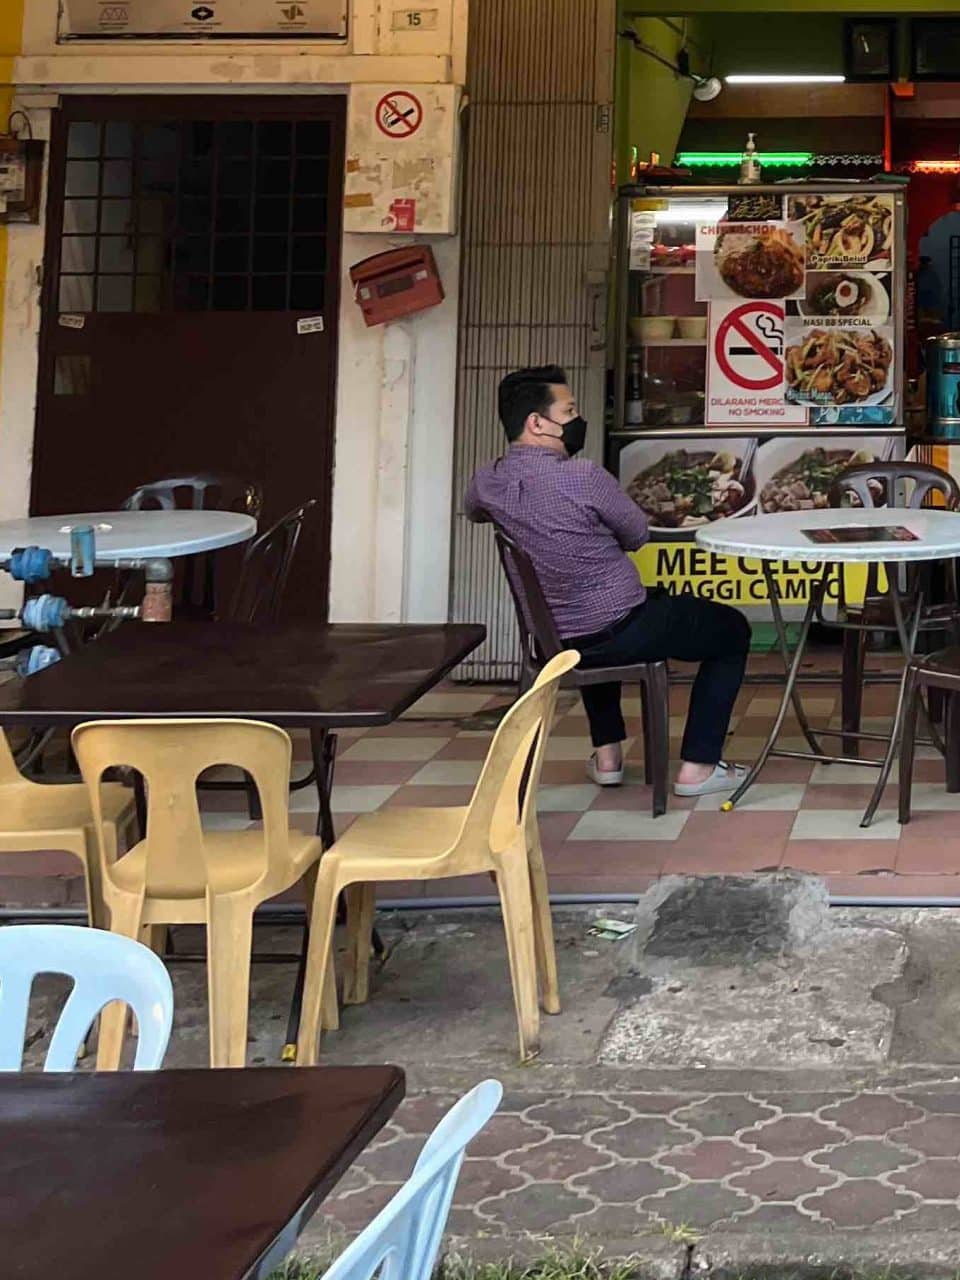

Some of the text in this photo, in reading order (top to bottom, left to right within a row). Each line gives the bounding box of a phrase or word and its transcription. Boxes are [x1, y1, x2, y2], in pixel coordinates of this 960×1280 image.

[406, 12, 422, 26] 15
[711, 397, 757, 406] DILARANG
[728, 407, 785, 417] NO SMOKING
[656, 548, 728, 576] MEE
[656, 579, 741, 601] MAGGI
